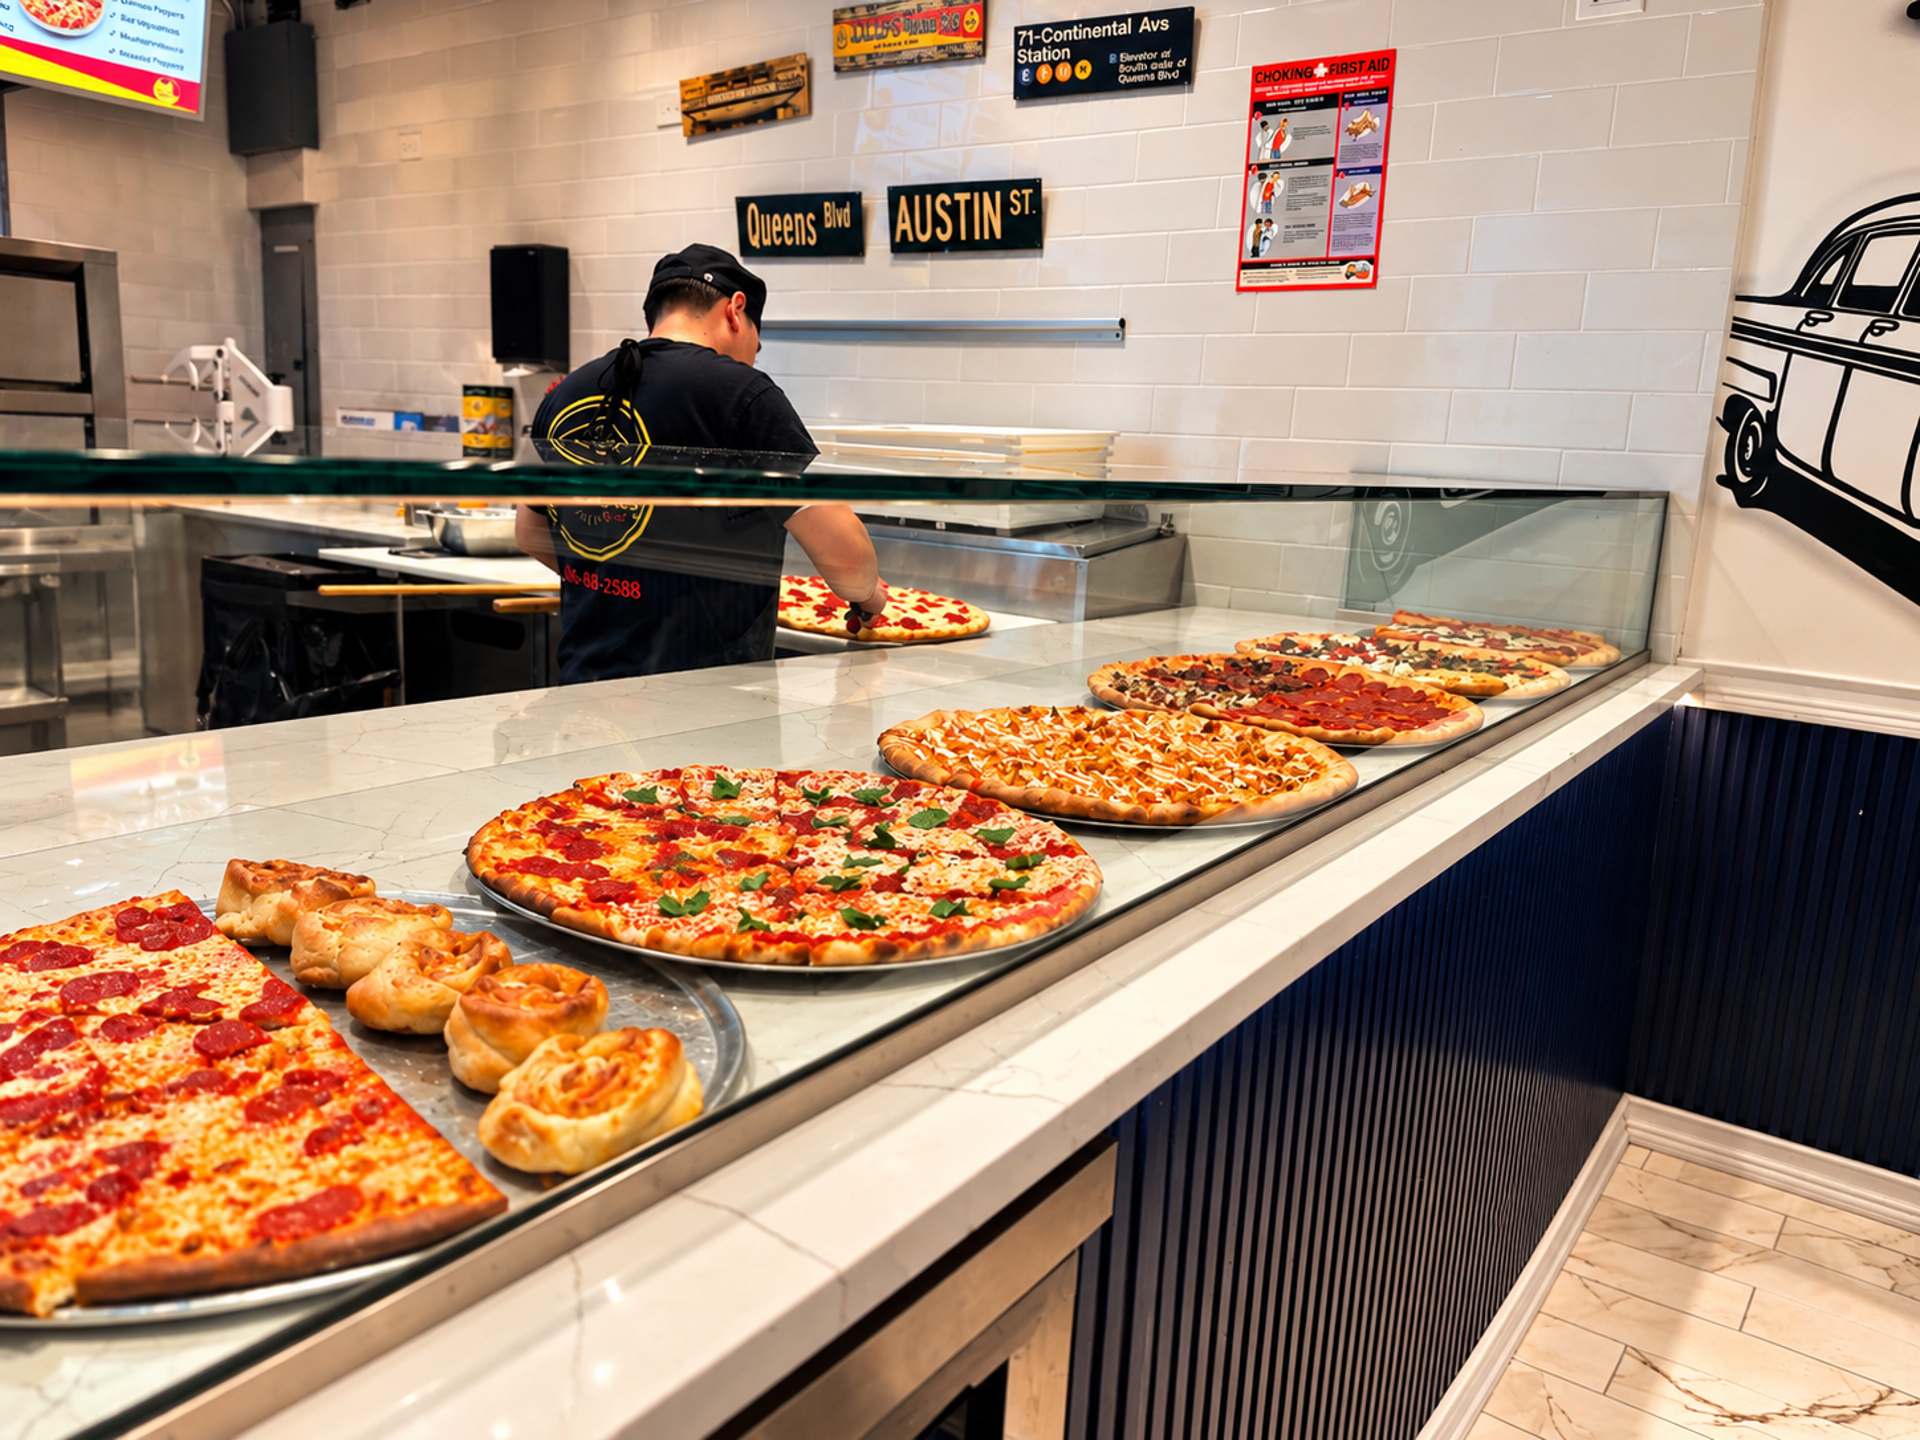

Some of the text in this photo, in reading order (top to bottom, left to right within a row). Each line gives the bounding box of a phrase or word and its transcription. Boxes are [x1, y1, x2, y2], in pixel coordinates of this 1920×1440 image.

[1017, 16, 1170, 47] 71-Continental Avs
[1016, 46, 1071, 65] Station
[1254, 57, 1391, 84] CHOKING FIRST AID
[746, 201, 851, 249] Queens Blvd
[894, 188, 1037, 244] AUSTIN ST.
